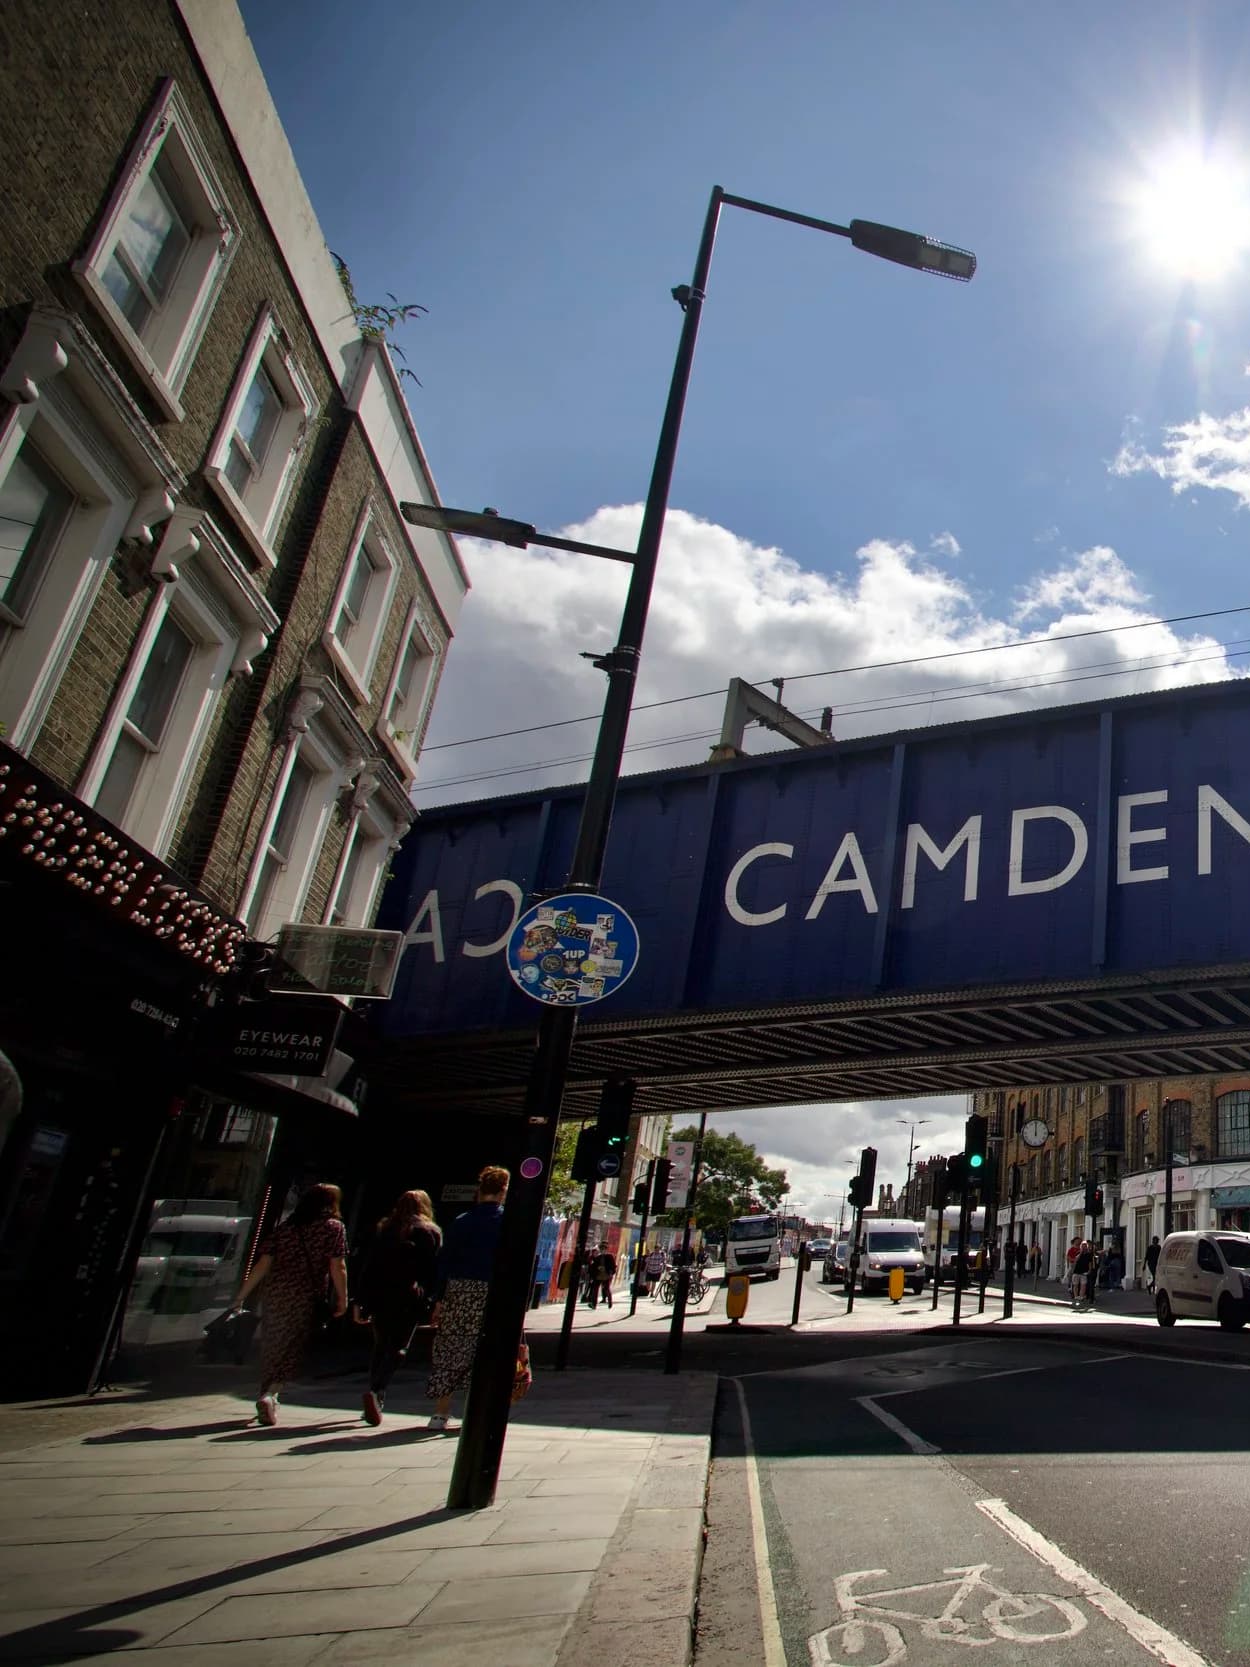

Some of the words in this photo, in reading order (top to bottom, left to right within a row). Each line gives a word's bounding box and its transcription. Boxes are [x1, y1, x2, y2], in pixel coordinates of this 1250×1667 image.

[562, 949, 586, 959] 1UP
[239, 1029, 323, 1048] EYEWEAR
[233, 1046, 257, 1056] 020
[293, 1051, 320, 1061] 1701
